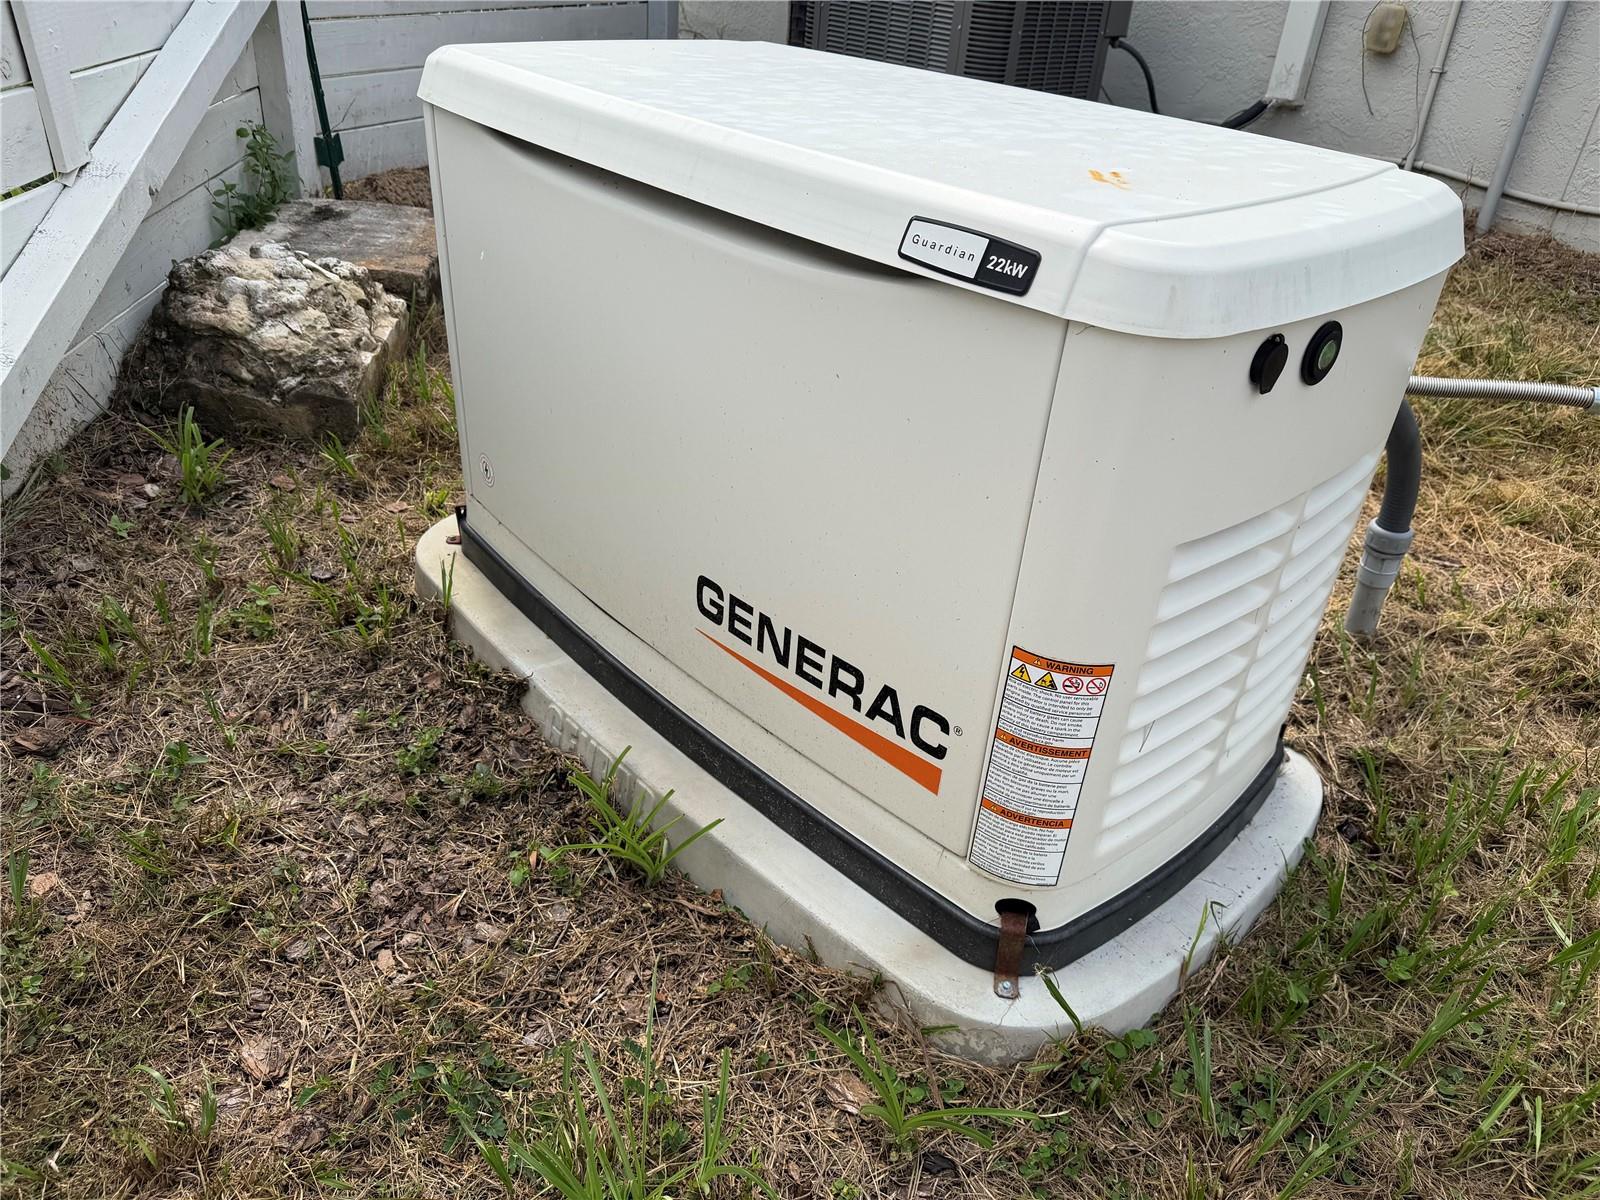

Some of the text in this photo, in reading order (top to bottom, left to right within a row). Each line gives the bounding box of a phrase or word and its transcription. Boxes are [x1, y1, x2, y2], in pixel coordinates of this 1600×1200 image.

[912, 234, 1029, 279] Guardian 22kW
[696, 574, 950, 760] GENERAC
[1046, 661, 1094, 675] WARNING
[1009, 736, 1088, 757] AVERTISSEMENT
[1000, 809, 1064, 828] ADVERTENCIA
